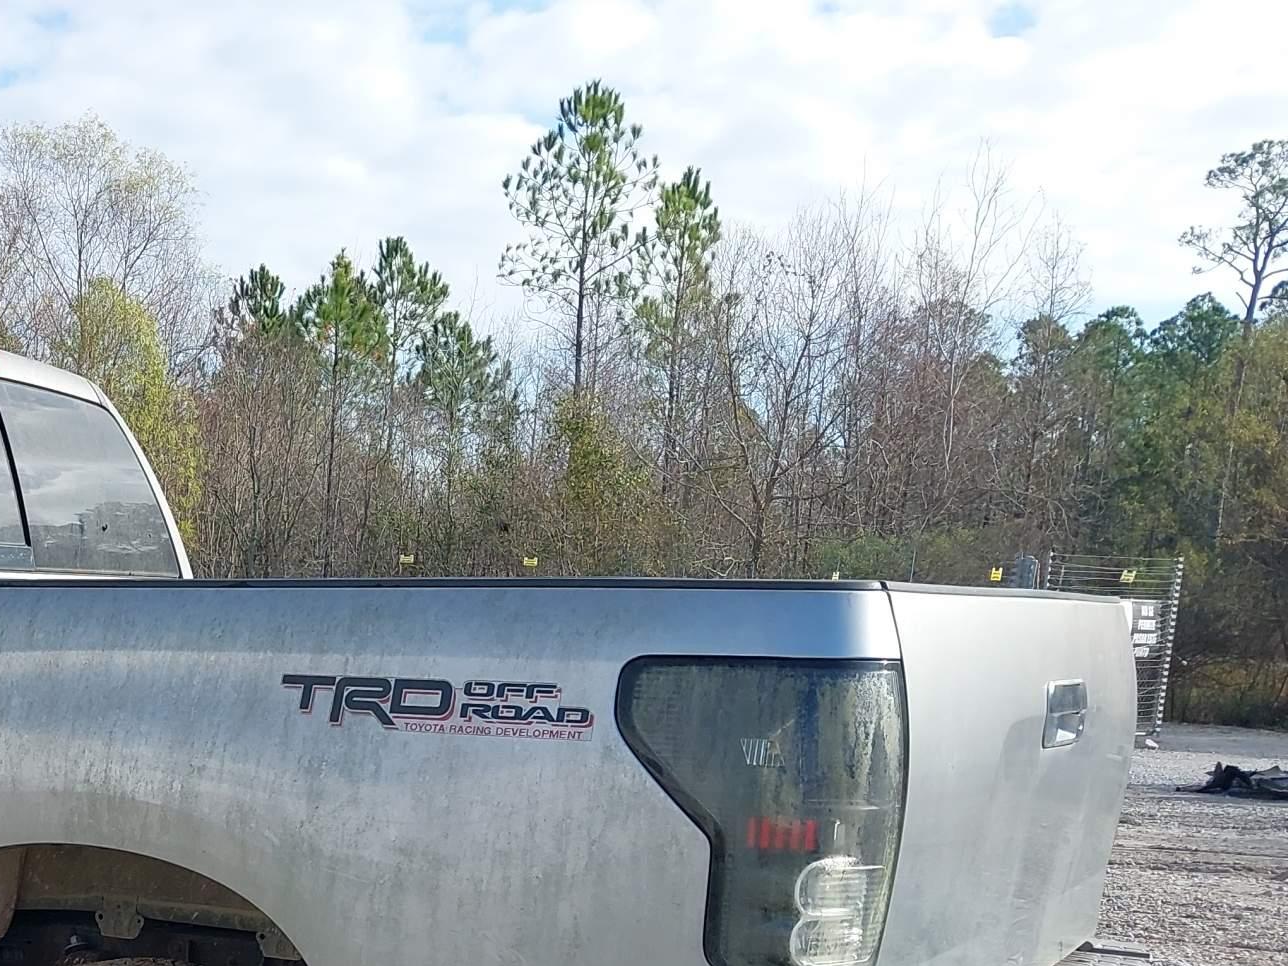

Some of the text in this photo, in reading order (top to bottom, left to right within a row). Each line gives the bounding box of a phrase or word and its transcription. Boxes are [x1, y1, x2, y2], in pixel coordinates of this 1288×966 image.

[281, 674, 456, 729] TRD
[463, 679, 561, 702] OFF
[459, 702, 593, 728] ROAD
[403, 722, 585, 741] TOYOTA RACING DEVELOPMENT
